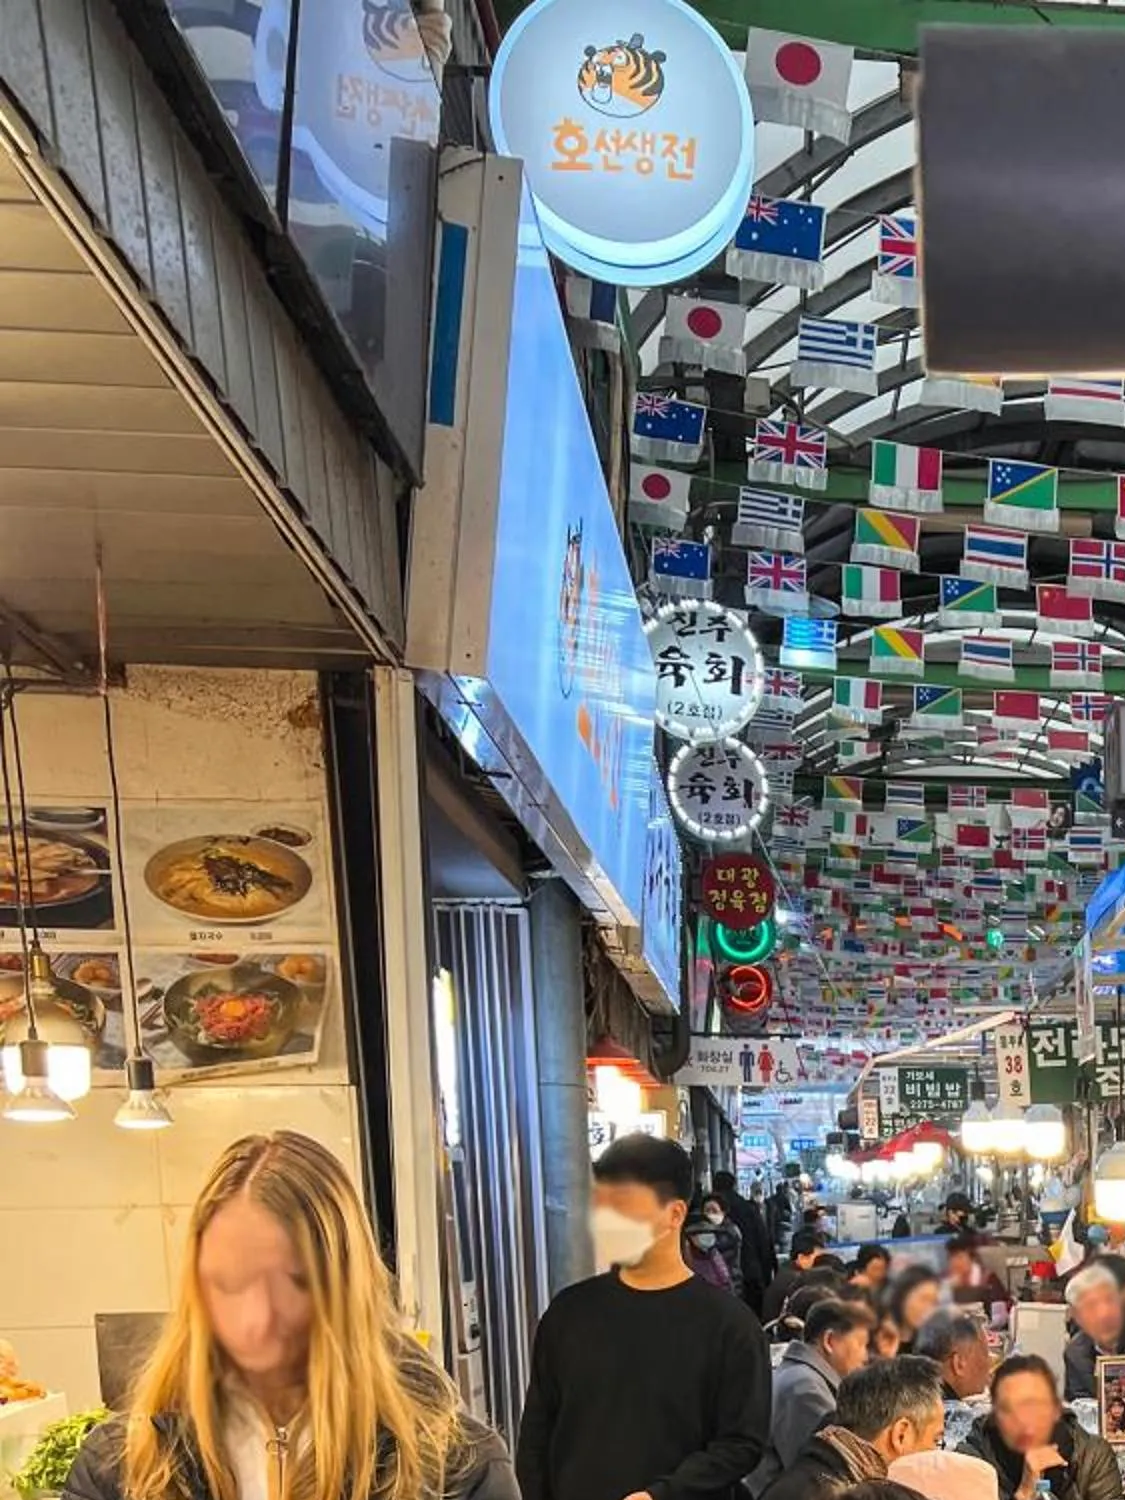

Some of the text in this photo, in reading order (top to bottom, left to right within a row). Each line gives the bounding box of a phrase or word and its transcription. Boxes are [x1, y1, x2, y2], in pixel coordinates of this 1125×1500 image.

[551, 116, 696, 181] 호선생전
[667, 610, 733, 642] 진주
[655, 646, 746, 696] 육회
[666, 702, 723, 721] (2호점)
[679, 774, 753, 809] 육회
[716, 867, 760, 889] 대광
[708, 889, 768, 913] 정육점
[697, 1050, 733, 1064] 화장실
[1005, 1055, 1023, 1074] 38
[905, 1082, 961, 1098] 비빔밥
